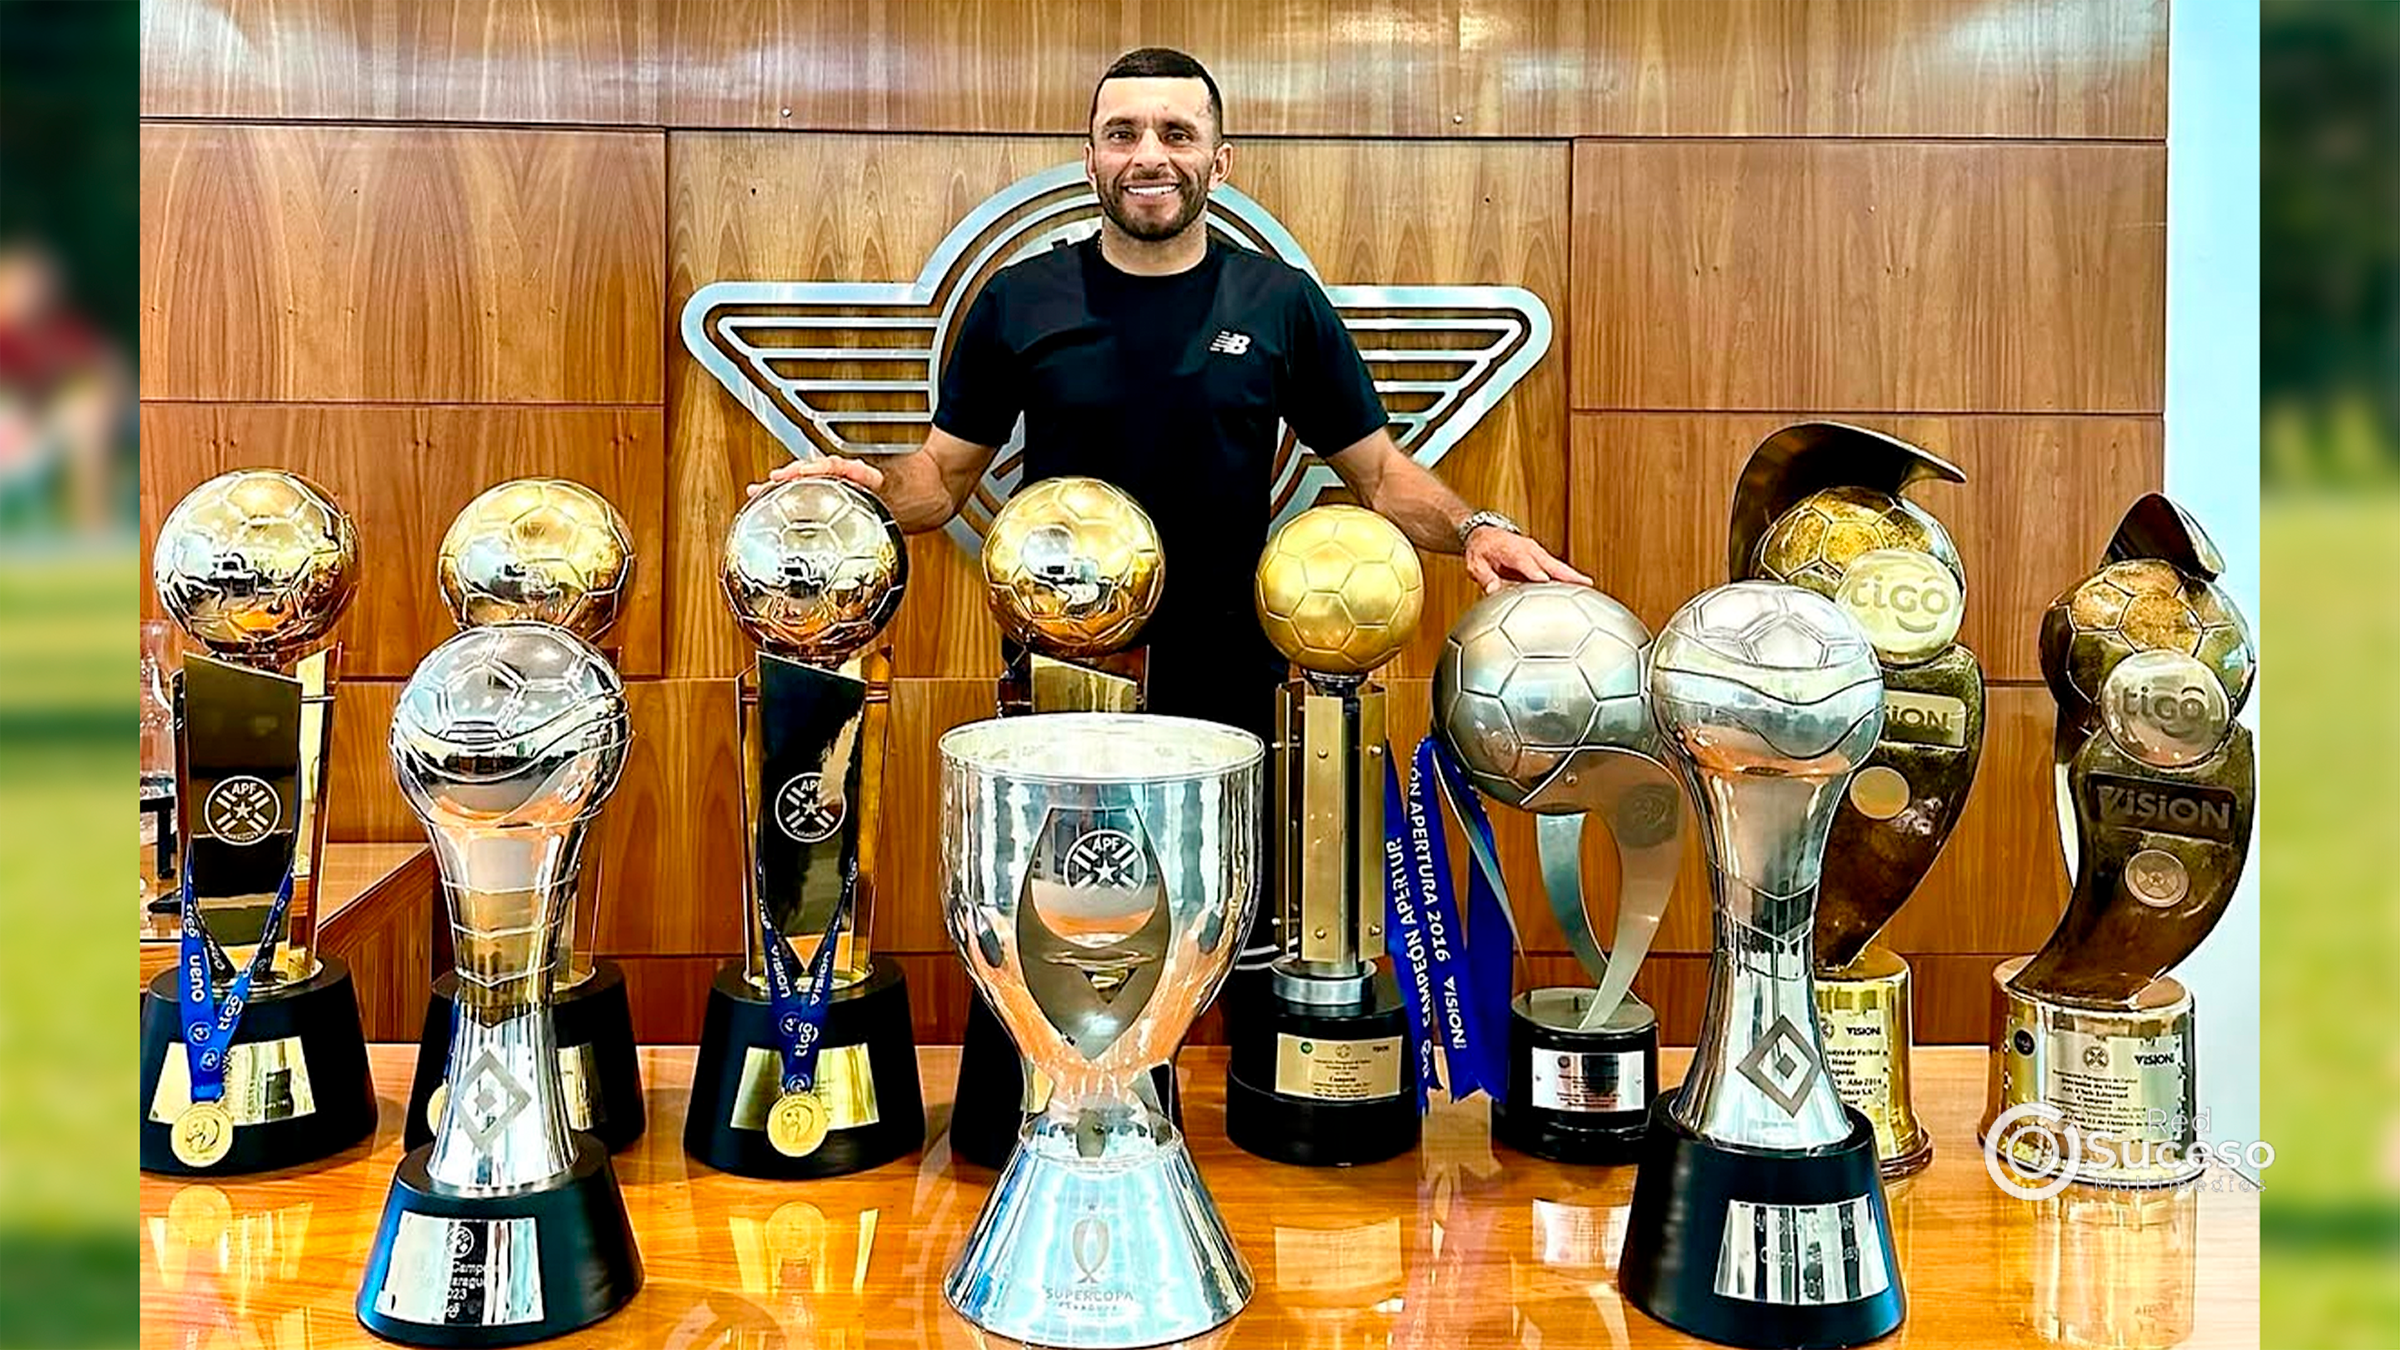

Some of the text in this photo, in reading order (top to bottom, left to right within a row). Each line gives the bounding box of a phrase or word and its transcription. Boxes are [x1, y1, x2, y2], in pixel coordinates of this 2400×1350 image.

[231, 782, 258, 795] APF
[1092, 837, 1121, 851] APF
[1409, 801, 1439, 906] APERTURA
[1427, 910, 1451, 962] 2016
[189, 954, 206, 1003] ueno
[1443, 975, 1467, 1044] VISION
[1045, 1287, 1134, 1302] SUPERCOPA
